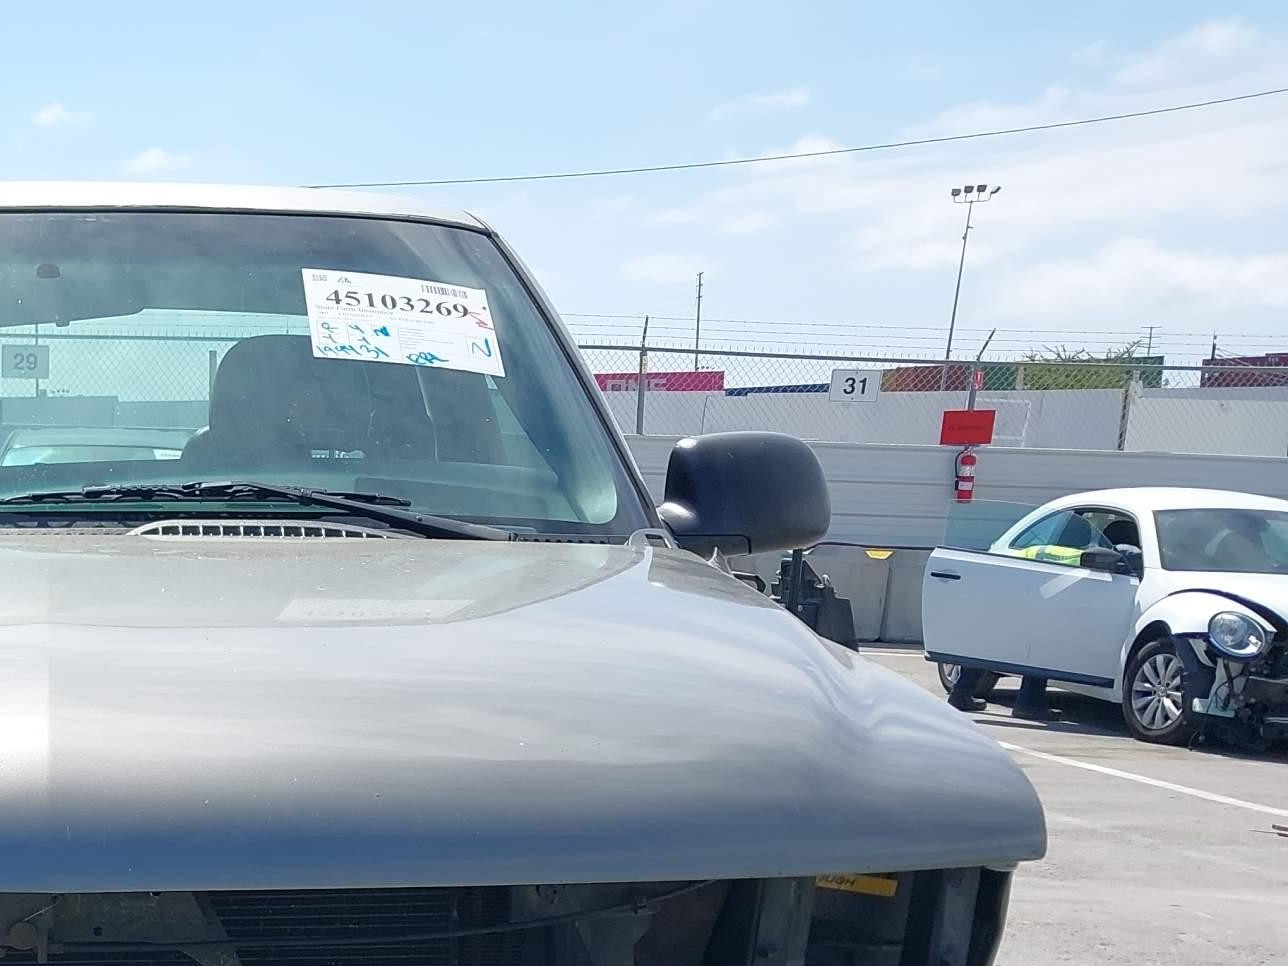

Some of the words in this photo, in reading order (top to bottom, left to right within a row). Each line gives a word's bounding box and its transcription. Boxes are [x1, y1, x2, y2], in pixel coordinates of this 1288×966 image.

[326, 289, 470, 319] 45103269
[14, 353, 38, 370] 29
[843, 377, 868, 395] 31
